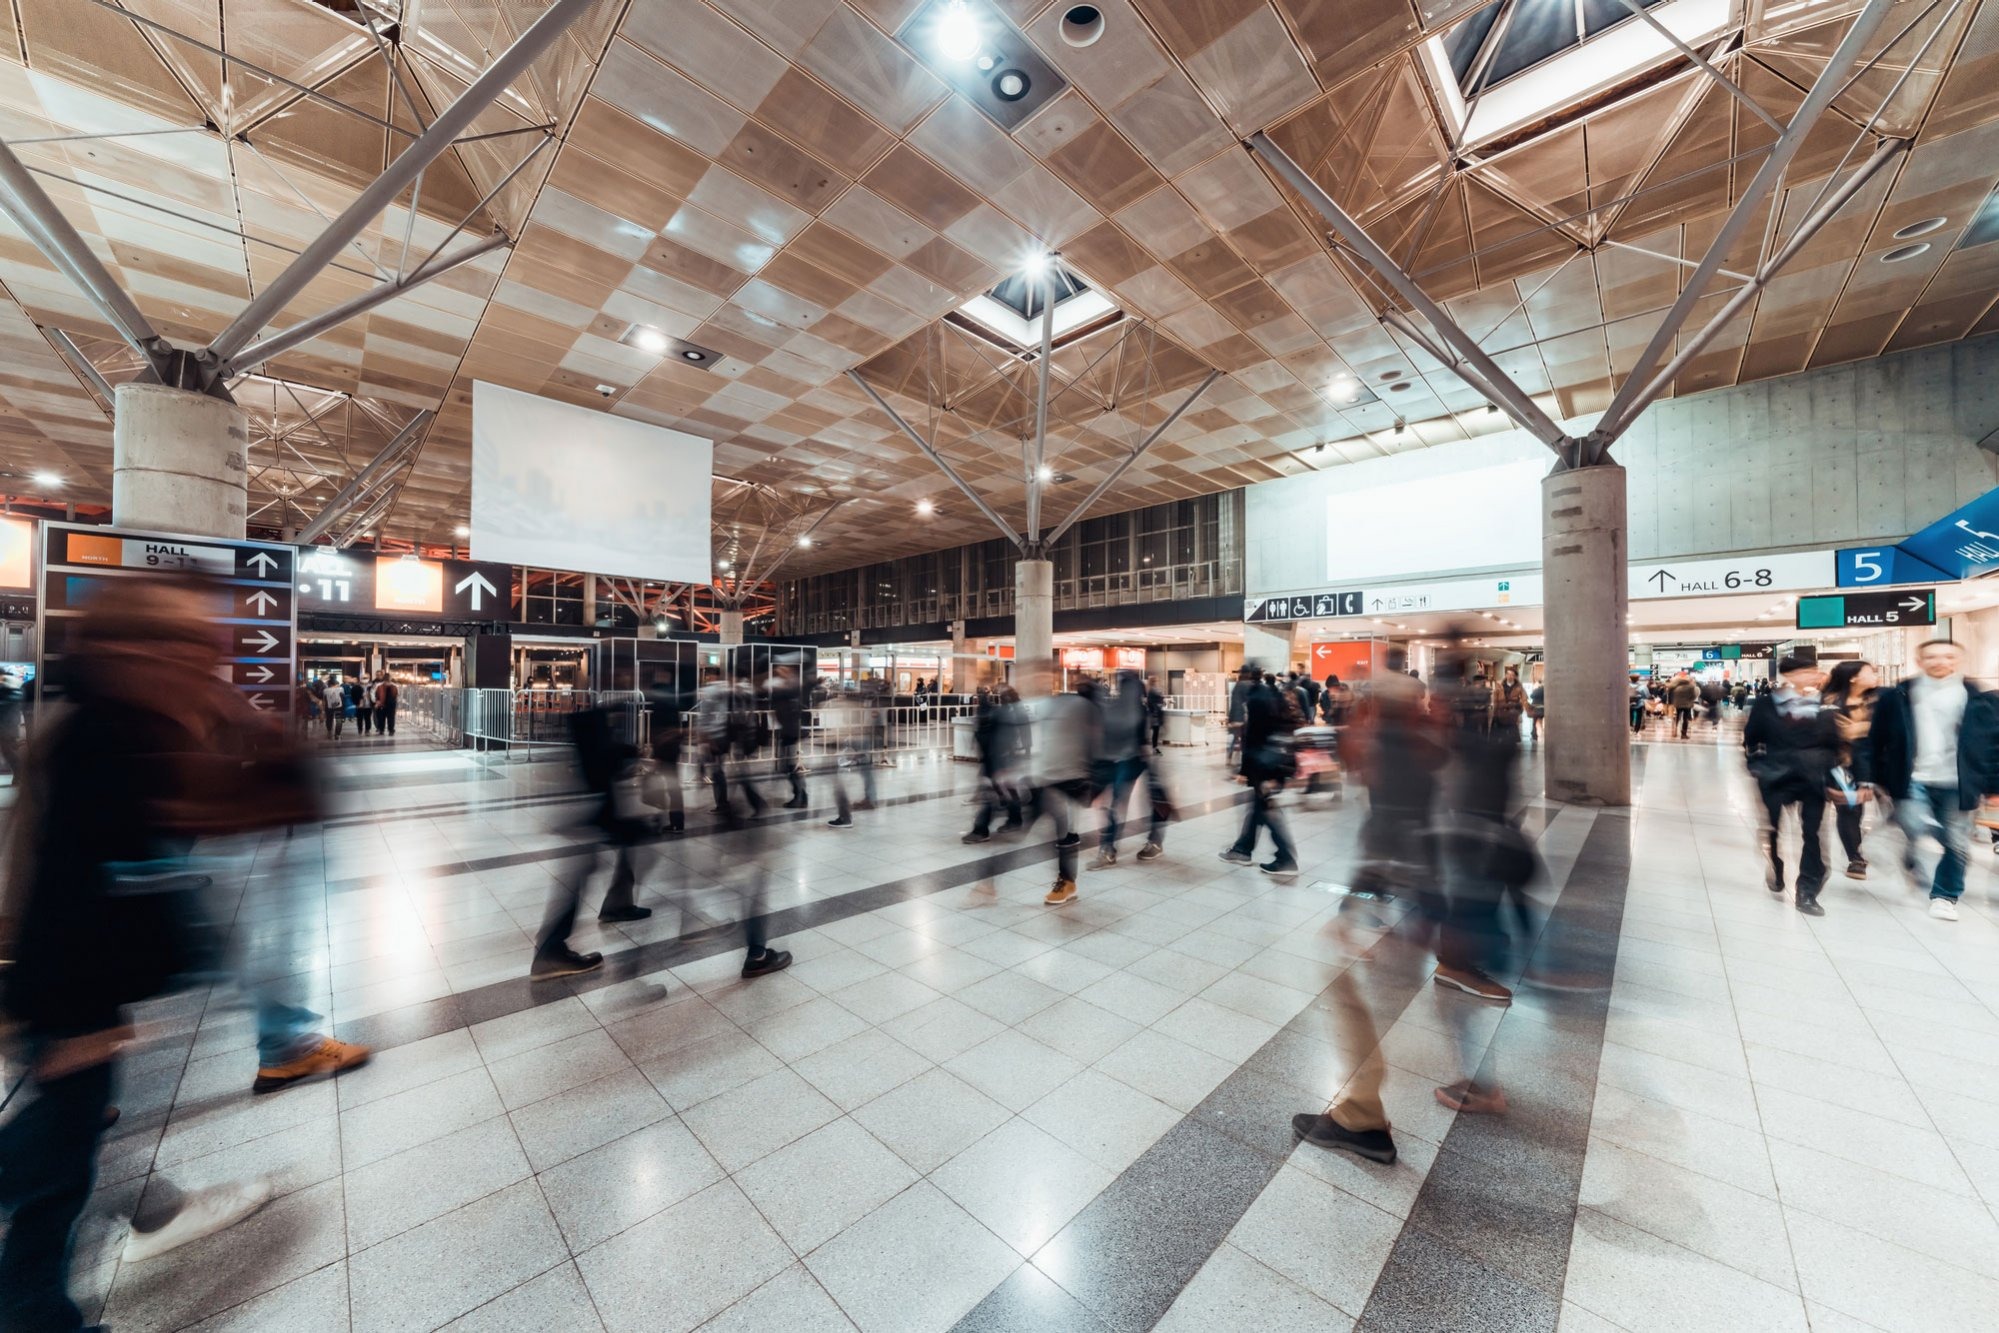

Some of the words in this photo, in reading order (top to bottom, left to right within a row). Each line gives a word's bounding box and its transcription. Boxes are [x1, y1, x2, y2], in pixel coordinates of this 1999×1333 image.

[145, 544, 190, 557] HALL
[1855, 552, 1882, 582] 5
[1681, 581, 1719, 592] HALL
[1724, 568, 1773, 589] 6-8
[1847, 615, 1883, 624] HALL
[1886, 611, 1899, 622] 5
[1706, 650, 1714, 659] 6
